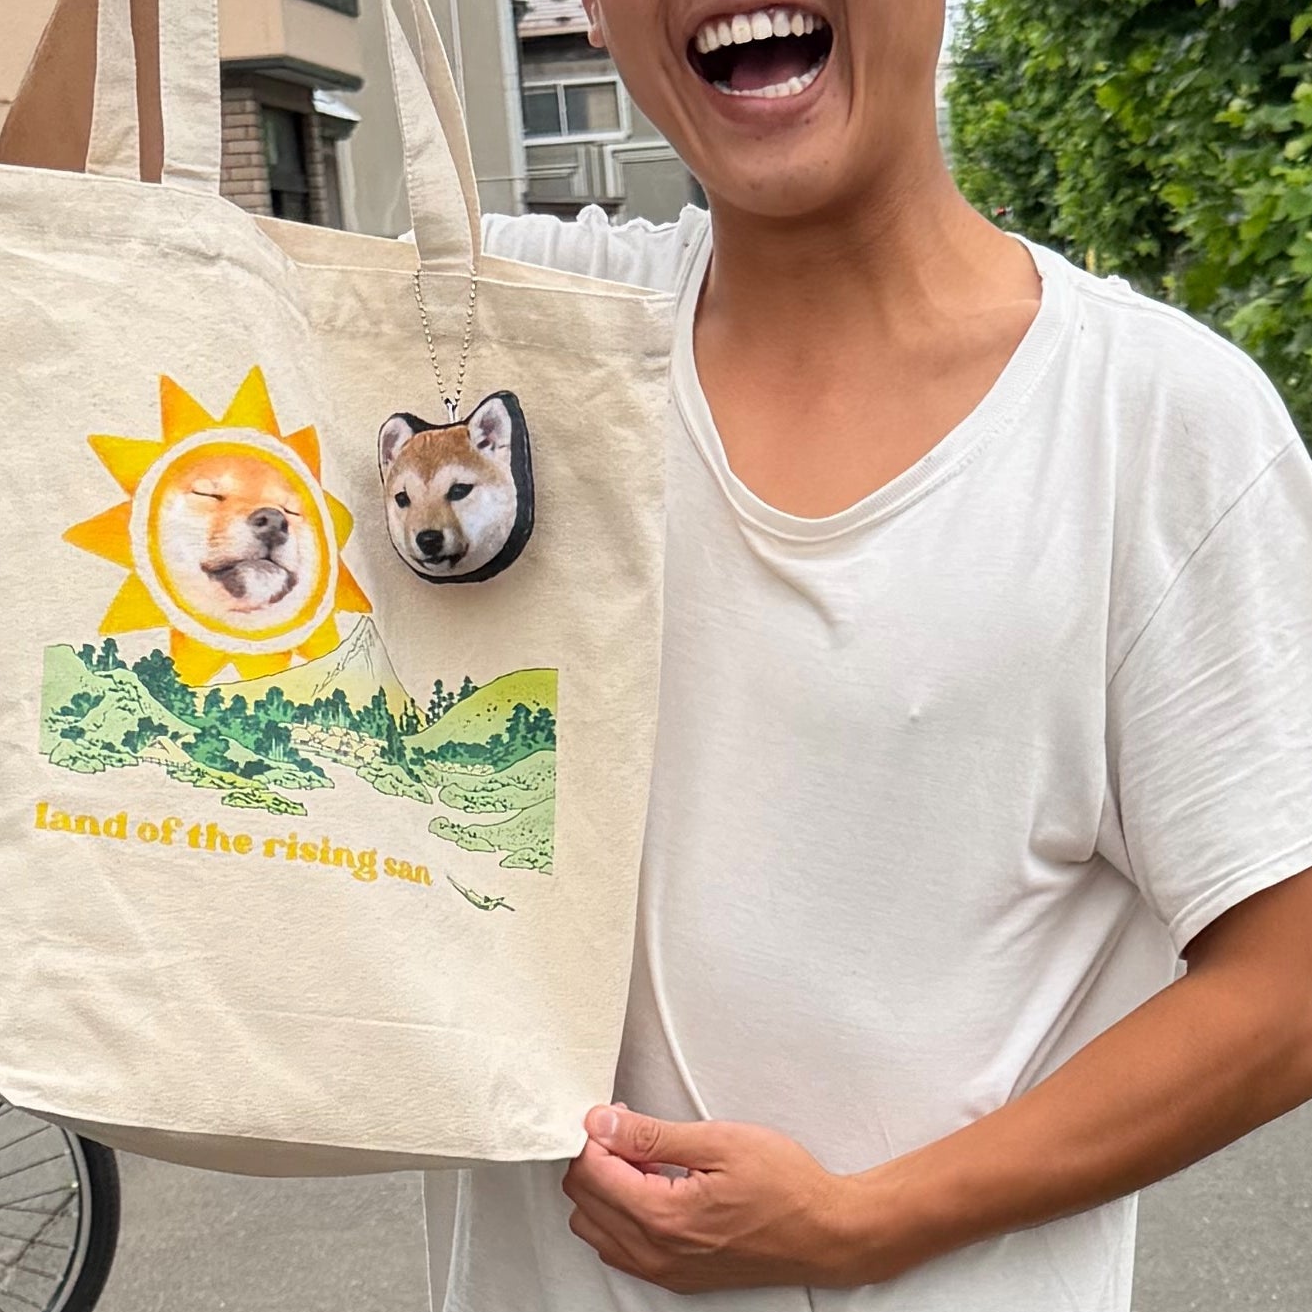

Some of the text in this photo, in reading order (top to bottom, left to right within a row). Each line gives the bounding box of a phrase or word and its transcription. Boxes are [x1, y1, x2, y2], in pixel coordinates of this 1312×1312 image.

[35, 800, 434, 886] land of the rising san
